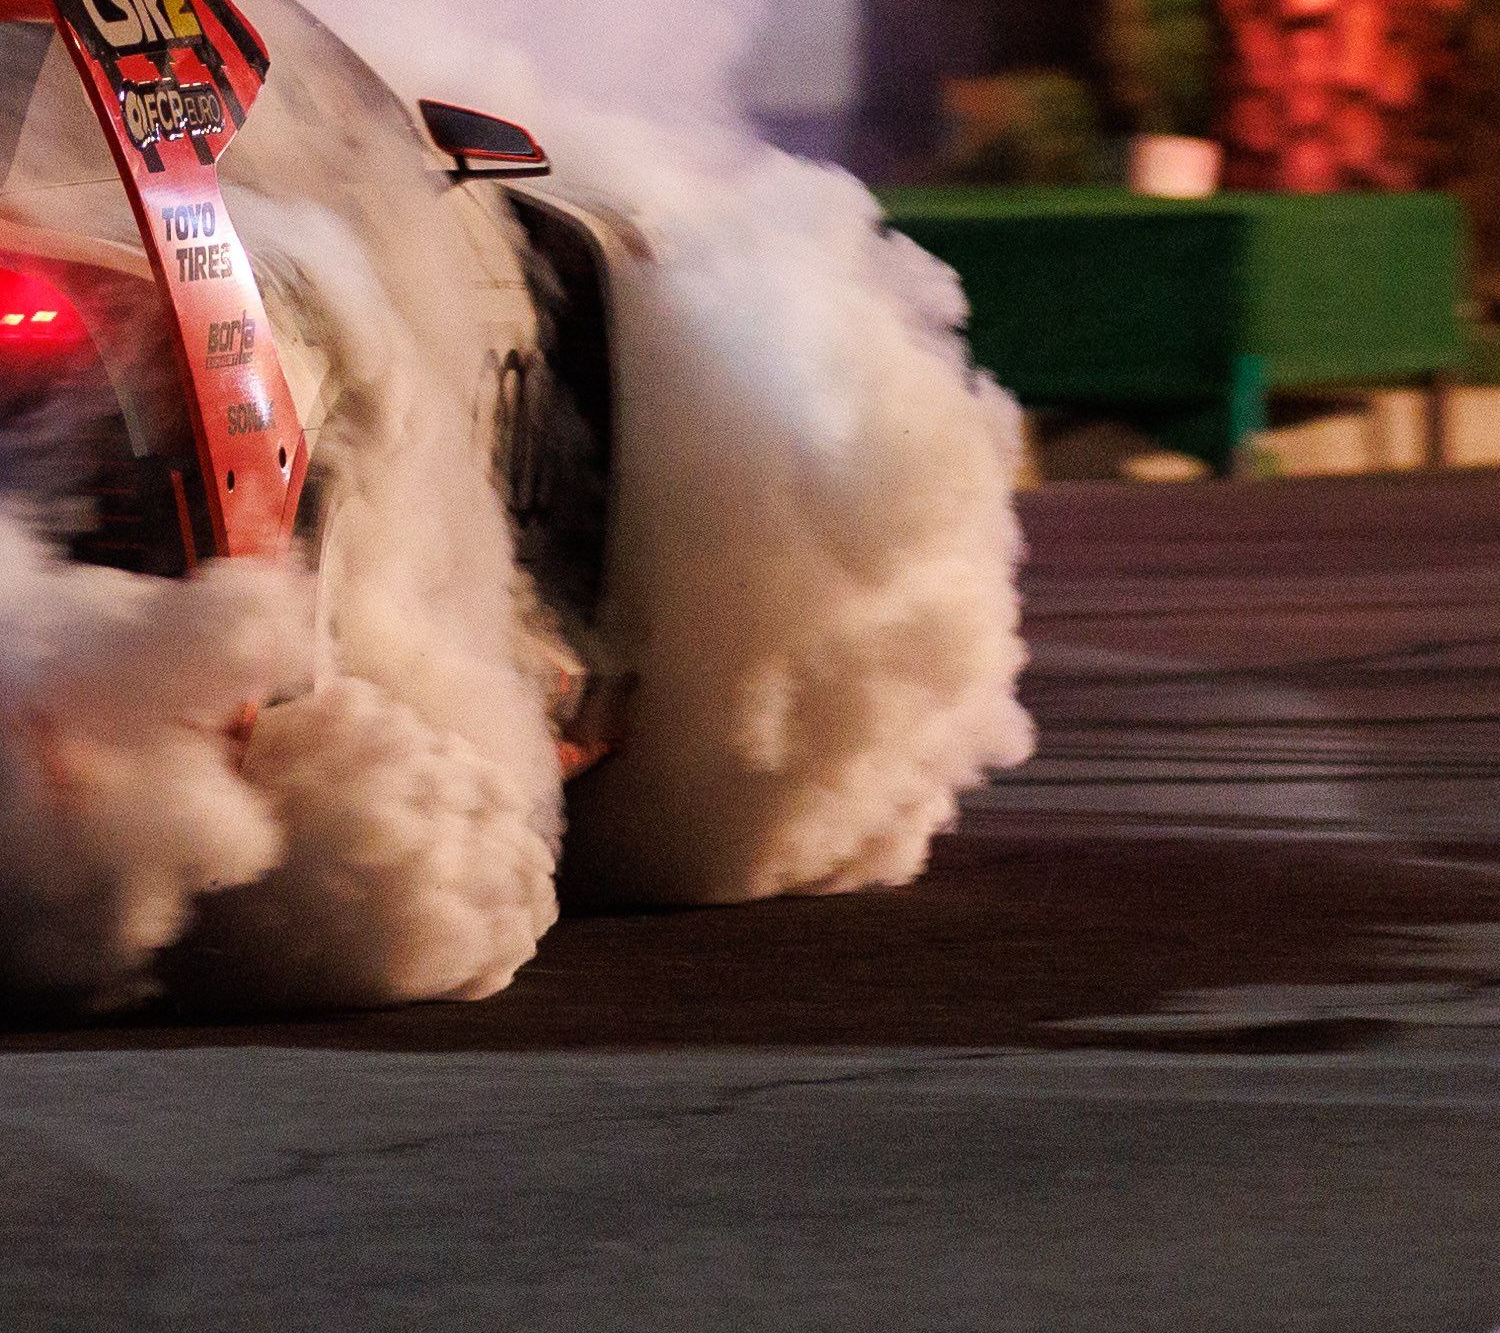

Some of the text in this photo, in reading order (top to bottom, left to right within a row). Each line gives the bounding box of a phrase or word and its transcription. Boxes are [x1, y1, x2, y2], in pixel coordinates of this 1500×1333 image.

[144, 89, 223, 135] FCP EURO
[161, 201, 216, 242] TOYO
[175, 242, 233, 283] TIRES
